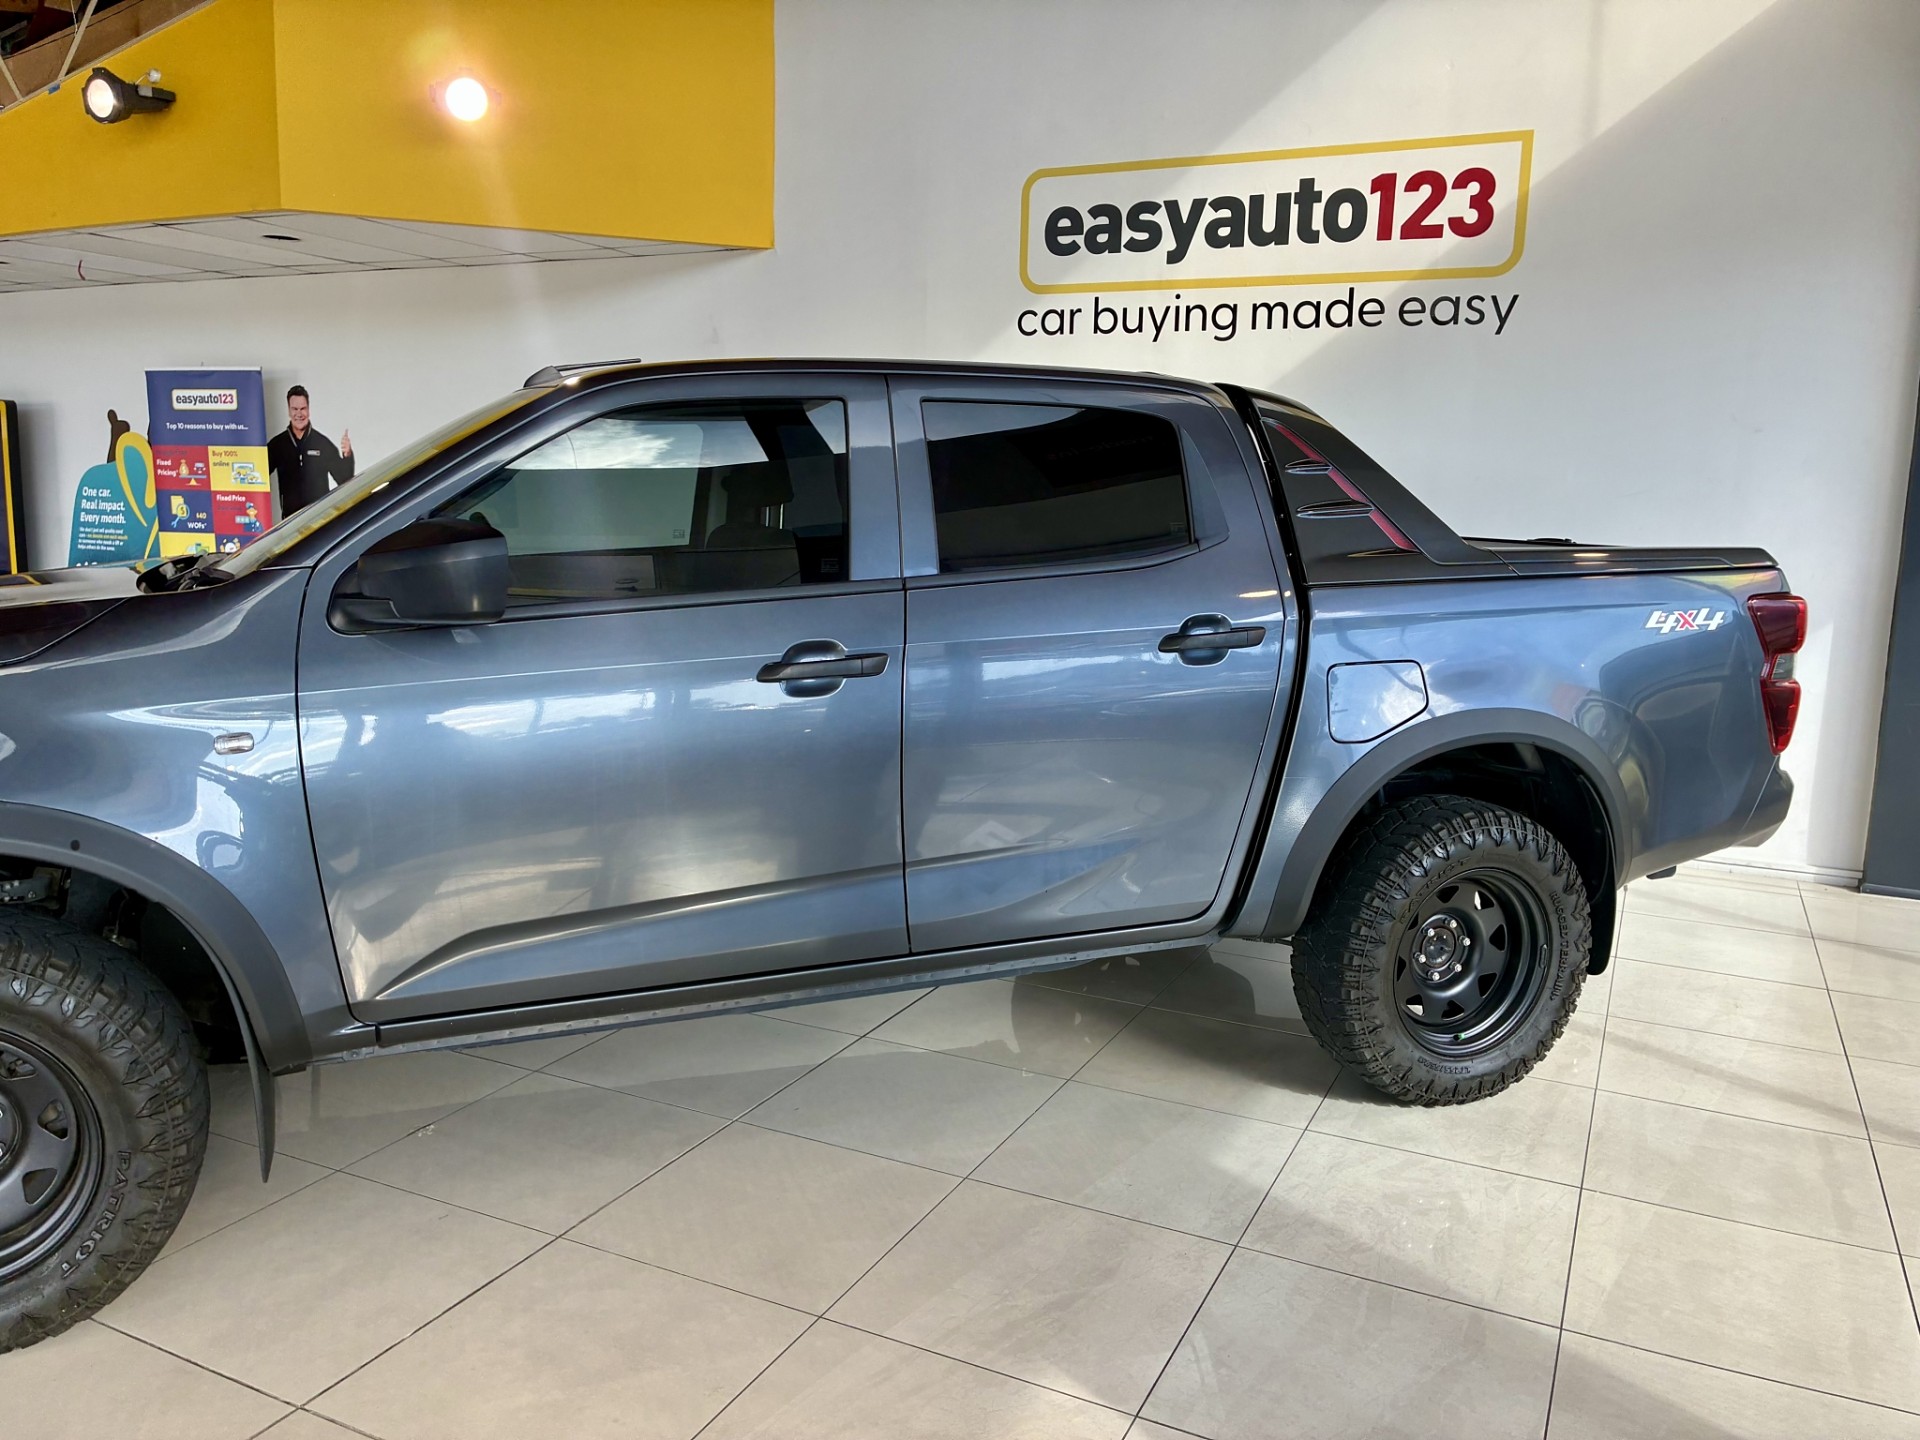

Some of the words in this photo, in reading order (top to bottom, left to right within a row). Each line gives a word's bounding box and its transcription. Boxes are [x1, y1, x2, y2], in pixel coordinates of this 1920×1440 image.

[1043, 166, 1498, 265] easyauto123
[1017, 306, 1083, 337] car
[1092, 293, 1239, 342] buying
[1250, 286, 1386, 331] made
[1397, 292, 1520, 336] easy
[175, 393, 234, 406] easyauto123
[166, 422, 177, 431] Top
[213, 423, 224, 431] buy
[82, 486, 97, 497] One
[98, 488, 112, 497] car.
[216, 494, 232, 502] Fixed
[232, 494, 246, 502] Price
[81, 499, 98, 510] Real
[98, 499, 126, 512] impact.
[80, 511, 100, 525] Every
[101, 513, 126, 524] month.
[1548, 890, 1569, 940] RUGGED
[61, 1150, 132, 1279] PATRIOT
